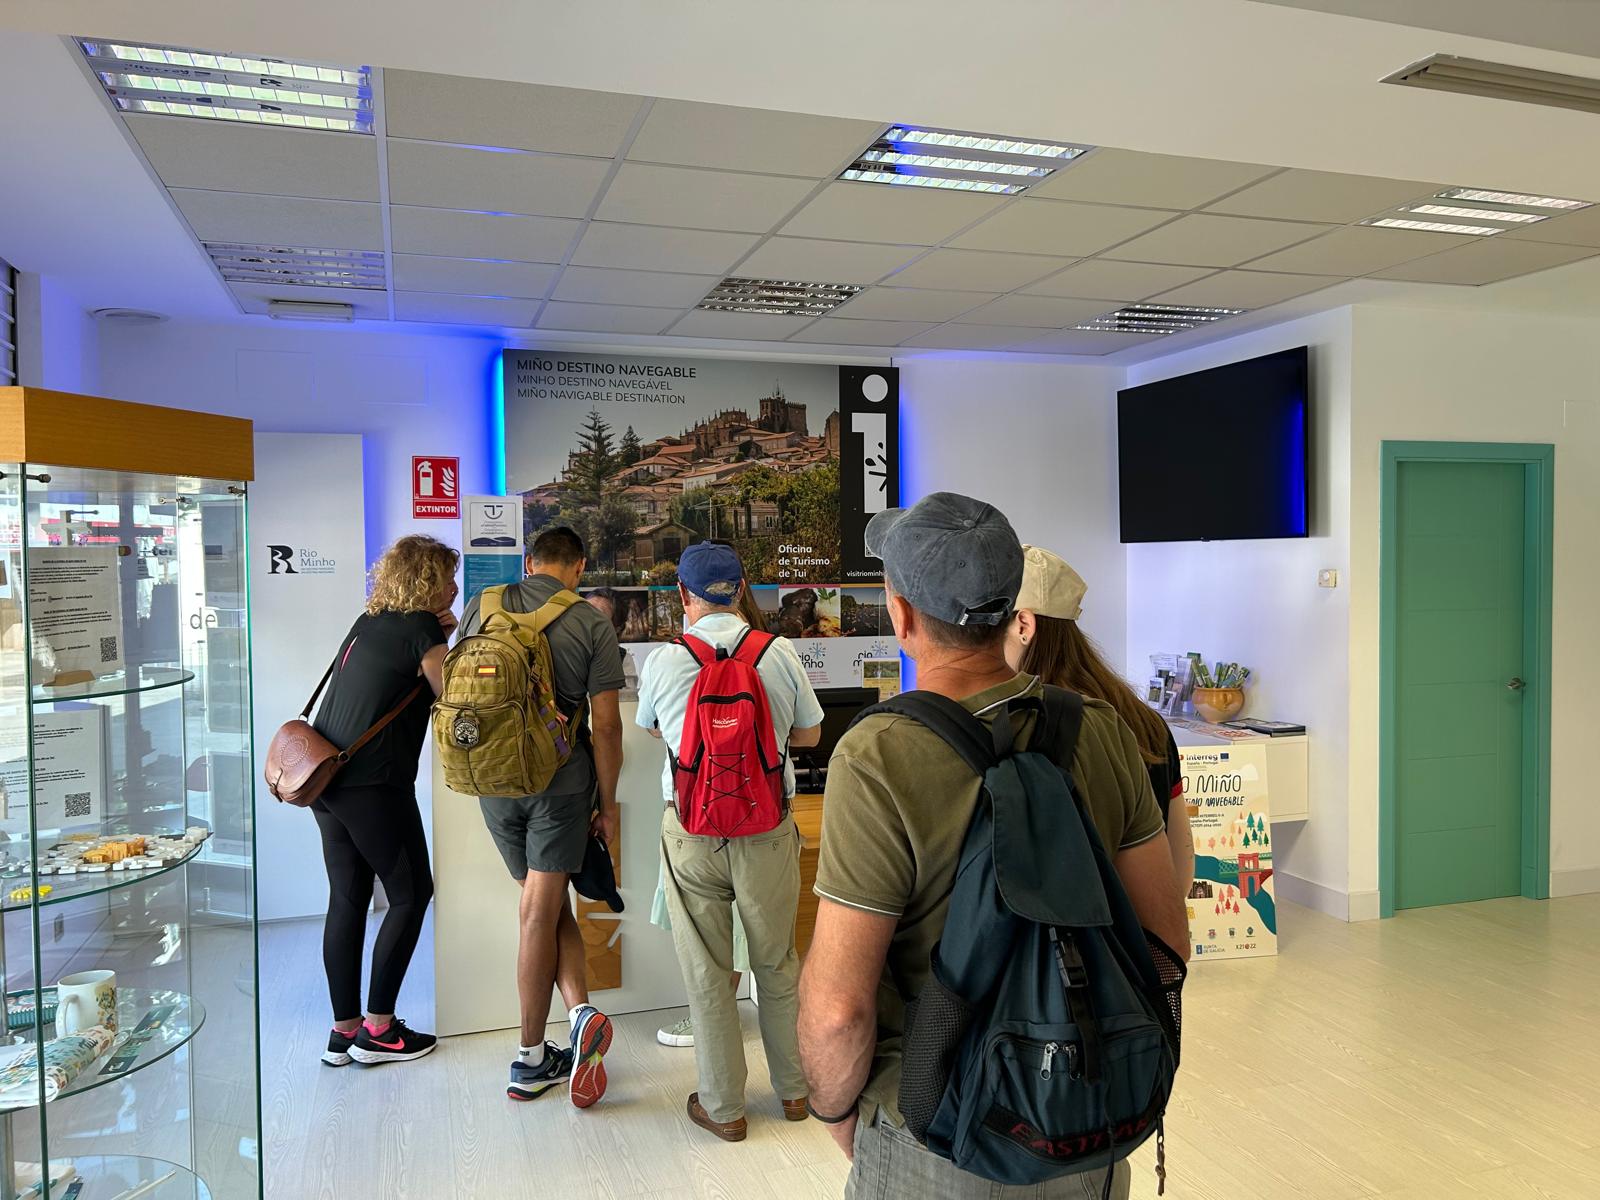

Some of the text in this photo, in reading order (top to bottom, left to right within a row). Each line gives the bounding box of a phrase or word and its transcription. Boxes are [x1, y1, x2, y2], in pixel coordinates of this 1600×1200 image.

[517, 358, 697, 378] MIÑO DESTINO NAVEGABLE
[517, 375, 672, 390] MINHO DESTINO NAVEGÁVEL
[517, 387, 685, 404] MIÑO NAVIGABLE DESTINATION
[416, 505, 457, 513] EXTINTOR
[300, 548, 318, 558] Rio
[778, 544, 813, 554] Oficina
[300, 558, 336, 567] Minho
[778, 556, 830, 566] de Turismo
[778, 569, 807, 578] de Tui
